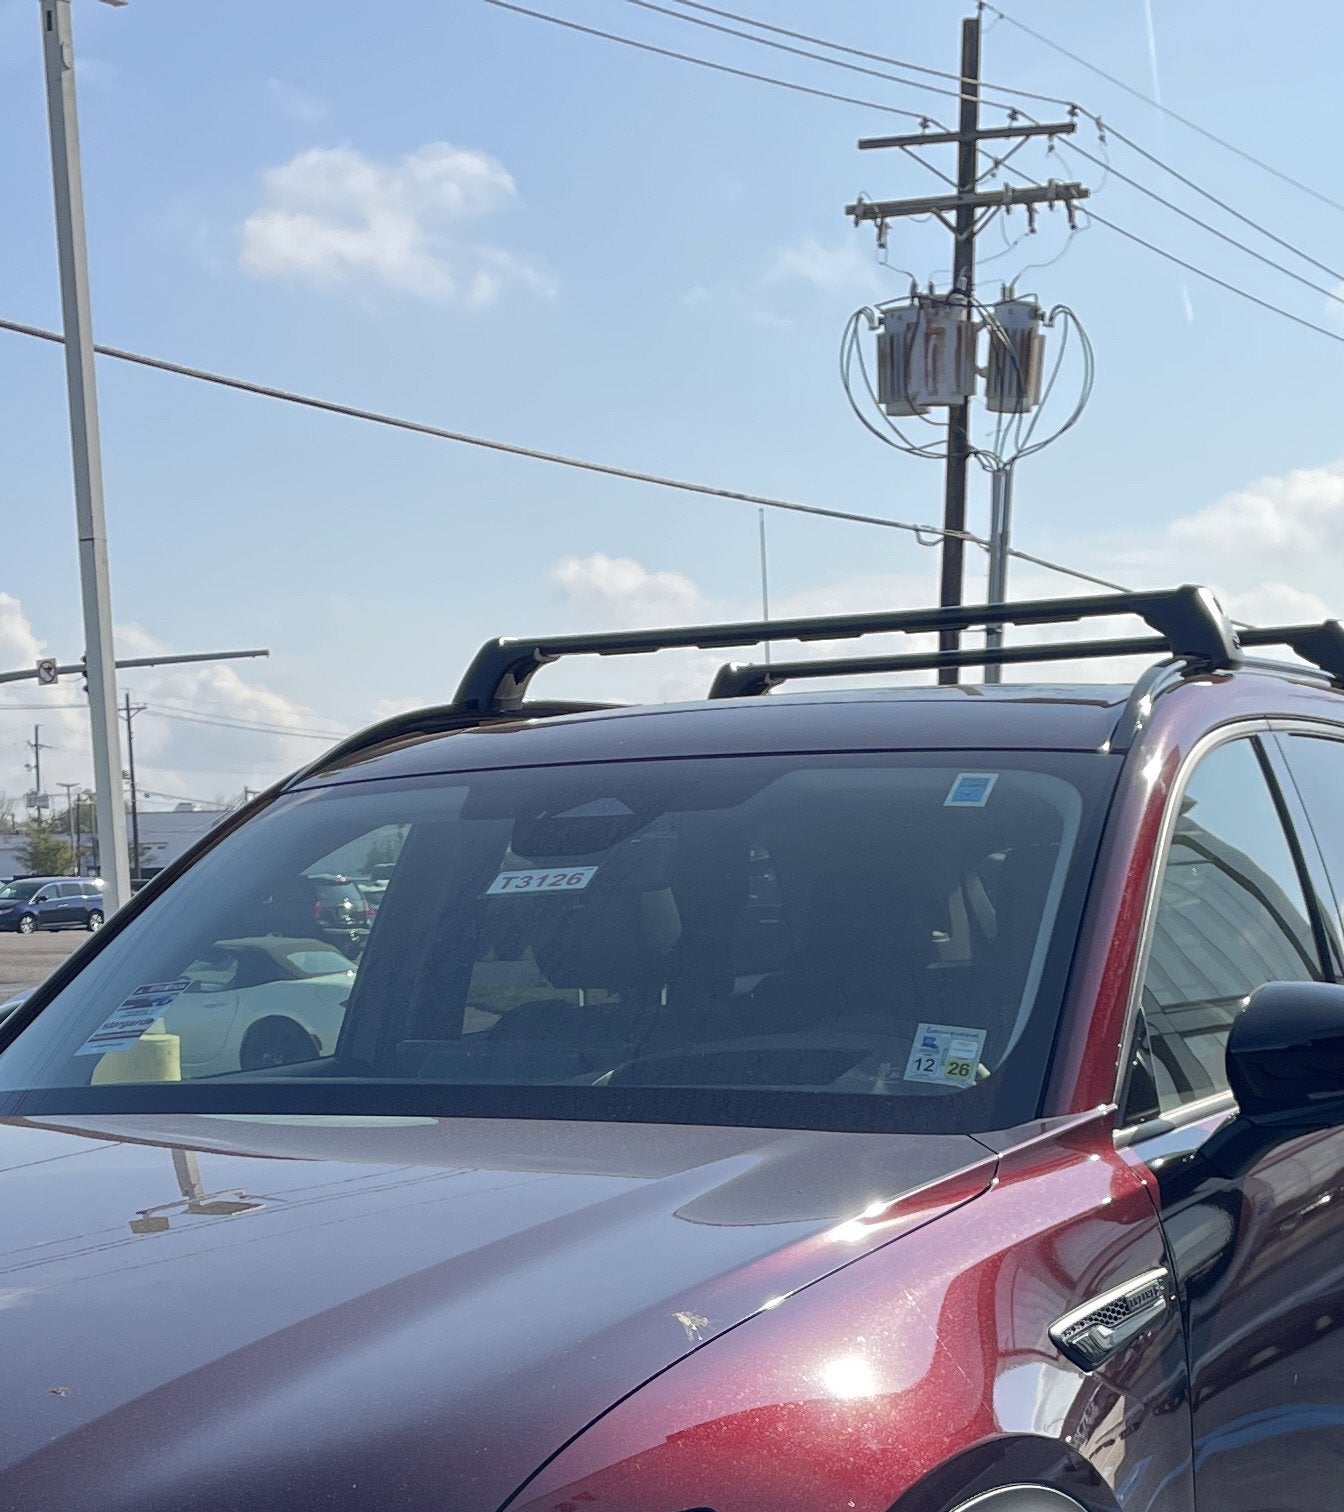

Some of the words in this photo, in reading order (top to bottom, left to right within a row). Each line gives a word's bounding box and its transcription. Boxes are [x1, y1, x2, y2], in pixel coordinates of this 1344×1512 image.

[500, 872, 585, 890] T3126
[915, 1057, 936, 1073] 12
[947, 1061, 971, 1077] 26
